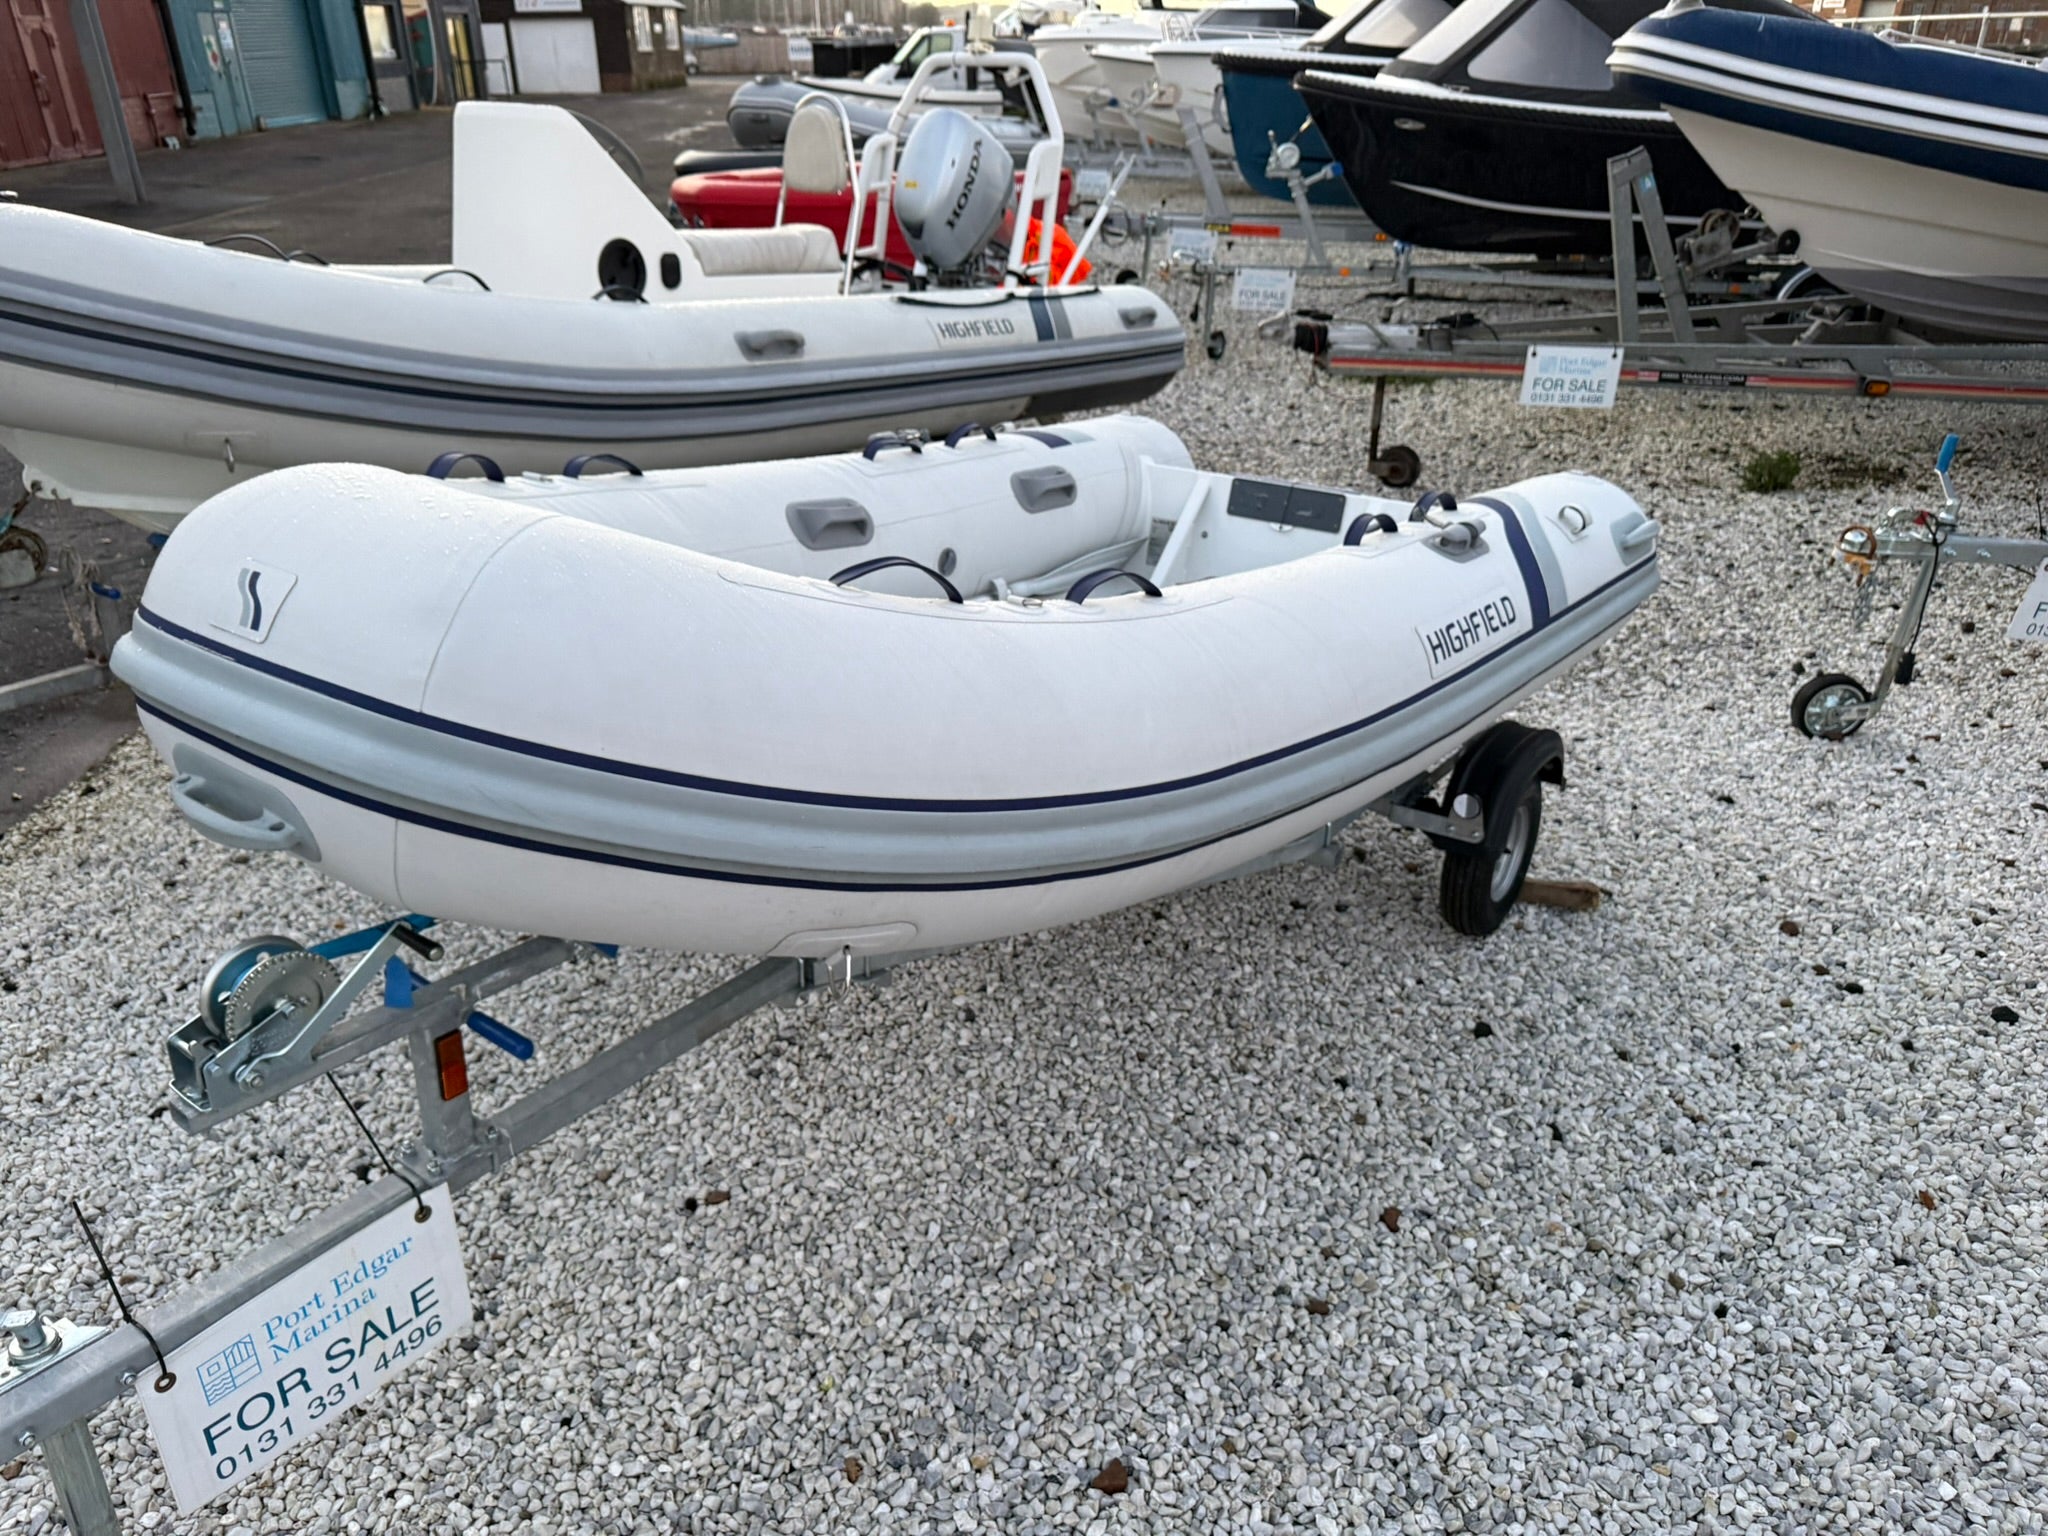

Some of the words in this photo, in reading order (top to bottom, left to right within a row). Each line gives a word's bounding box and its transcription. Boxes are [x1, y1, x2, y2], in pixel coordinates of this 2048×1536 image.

[946, 139, 982, 230] HONDA
[937, 318, 1015, 340] HIGHFIELD
[1532, 377, 1564, 392] FOR
[1568, 379, 1607, 394] SALE
[1426, 596, 1516, 664] HIGHFIELD
[261, 1292, 326, 1343] Port
[330, 1237, 413, 1299] Edgar
[268, 1287, 377, 1364] Marina
[203, 1367, 312, 1456] FOR
[325, 1277, 439, 1374] SALE
[216, 1416, 293, 1480] 0131
[307, 1371, 359, 1420] 331
[373, 1314, 442, 1375] 4496
